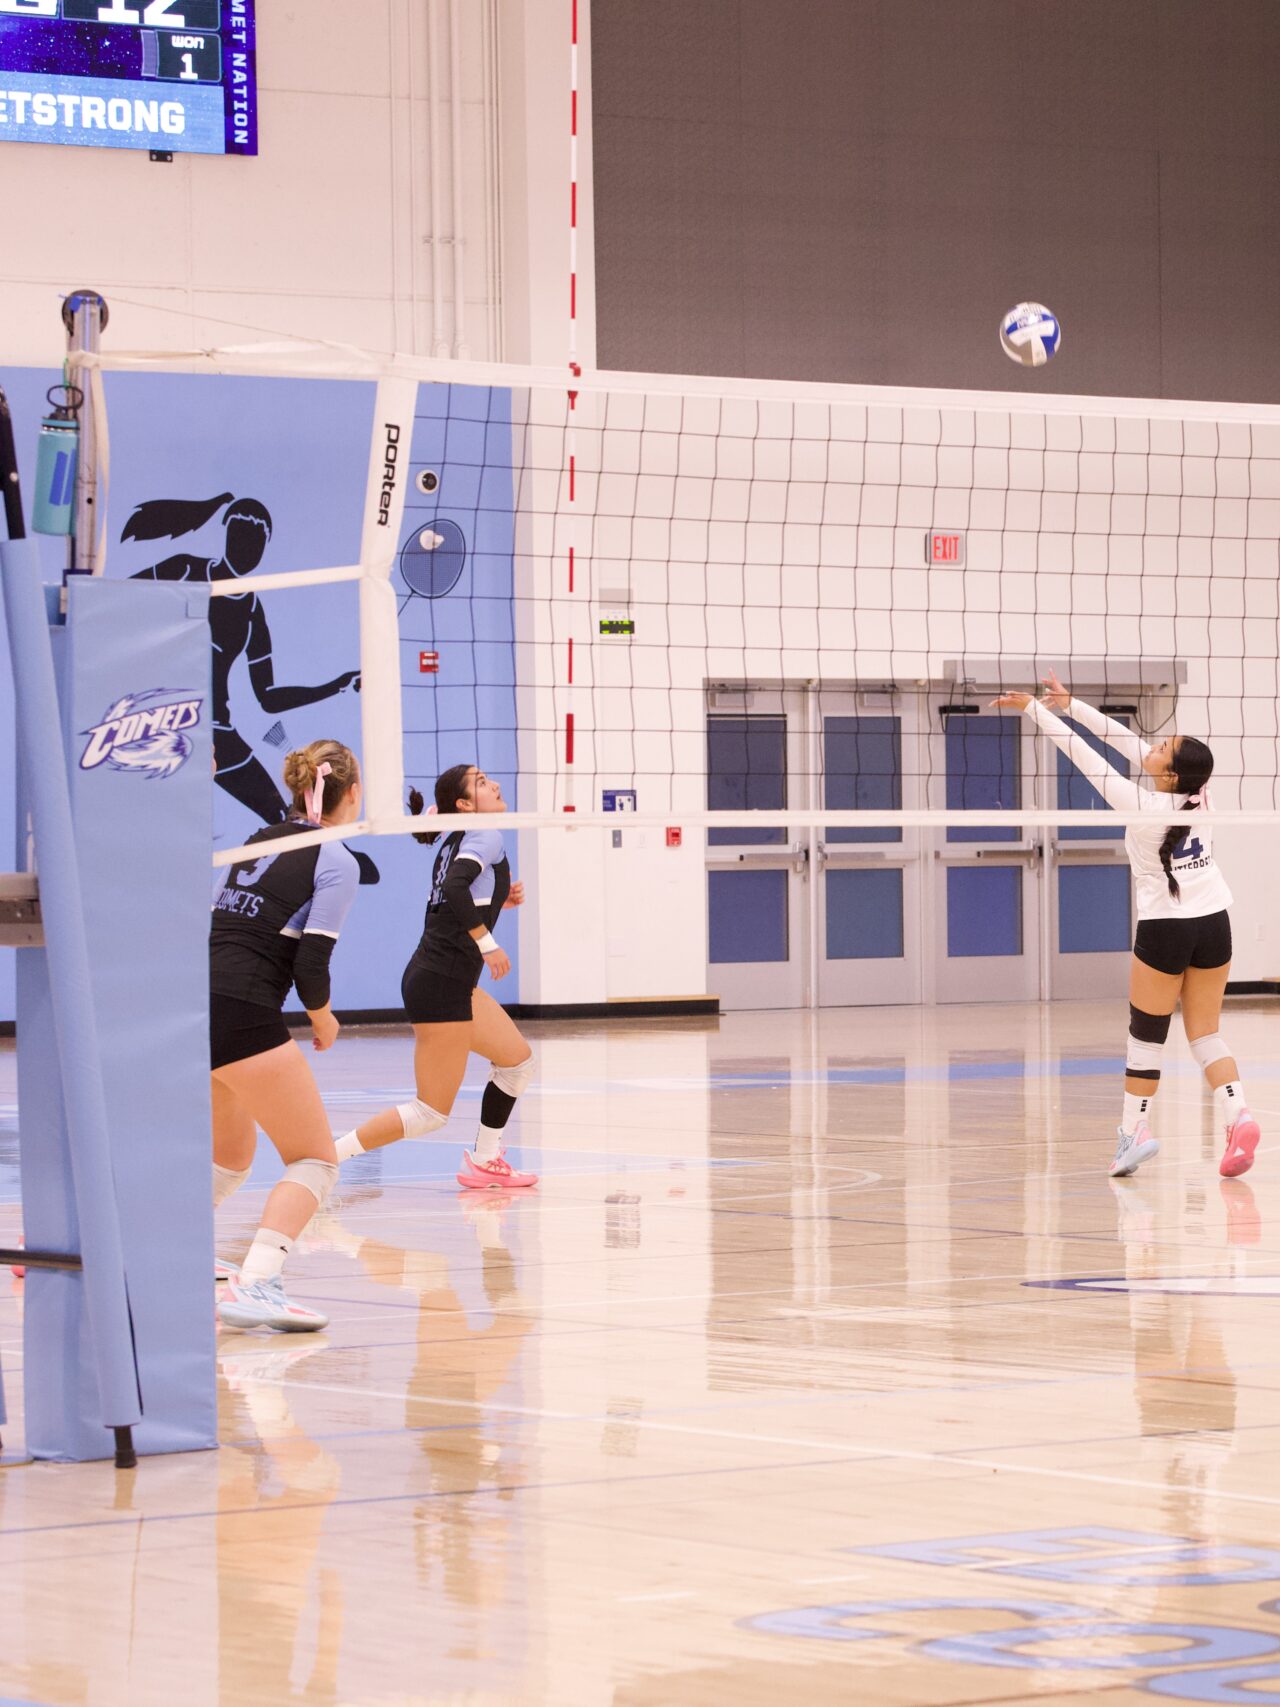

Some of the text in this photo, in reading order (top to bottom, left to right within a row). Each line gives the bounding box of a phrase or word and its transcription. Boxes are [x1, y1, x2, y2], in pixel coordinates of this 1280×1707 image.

[180, 53, 198, 80] 1
[232, 53, 248, 144] NATION
[933, 535, 960, 560] EXIT
[78, 698, 205, 771] COMETS
[1171, 832, 1204, 861] 4
